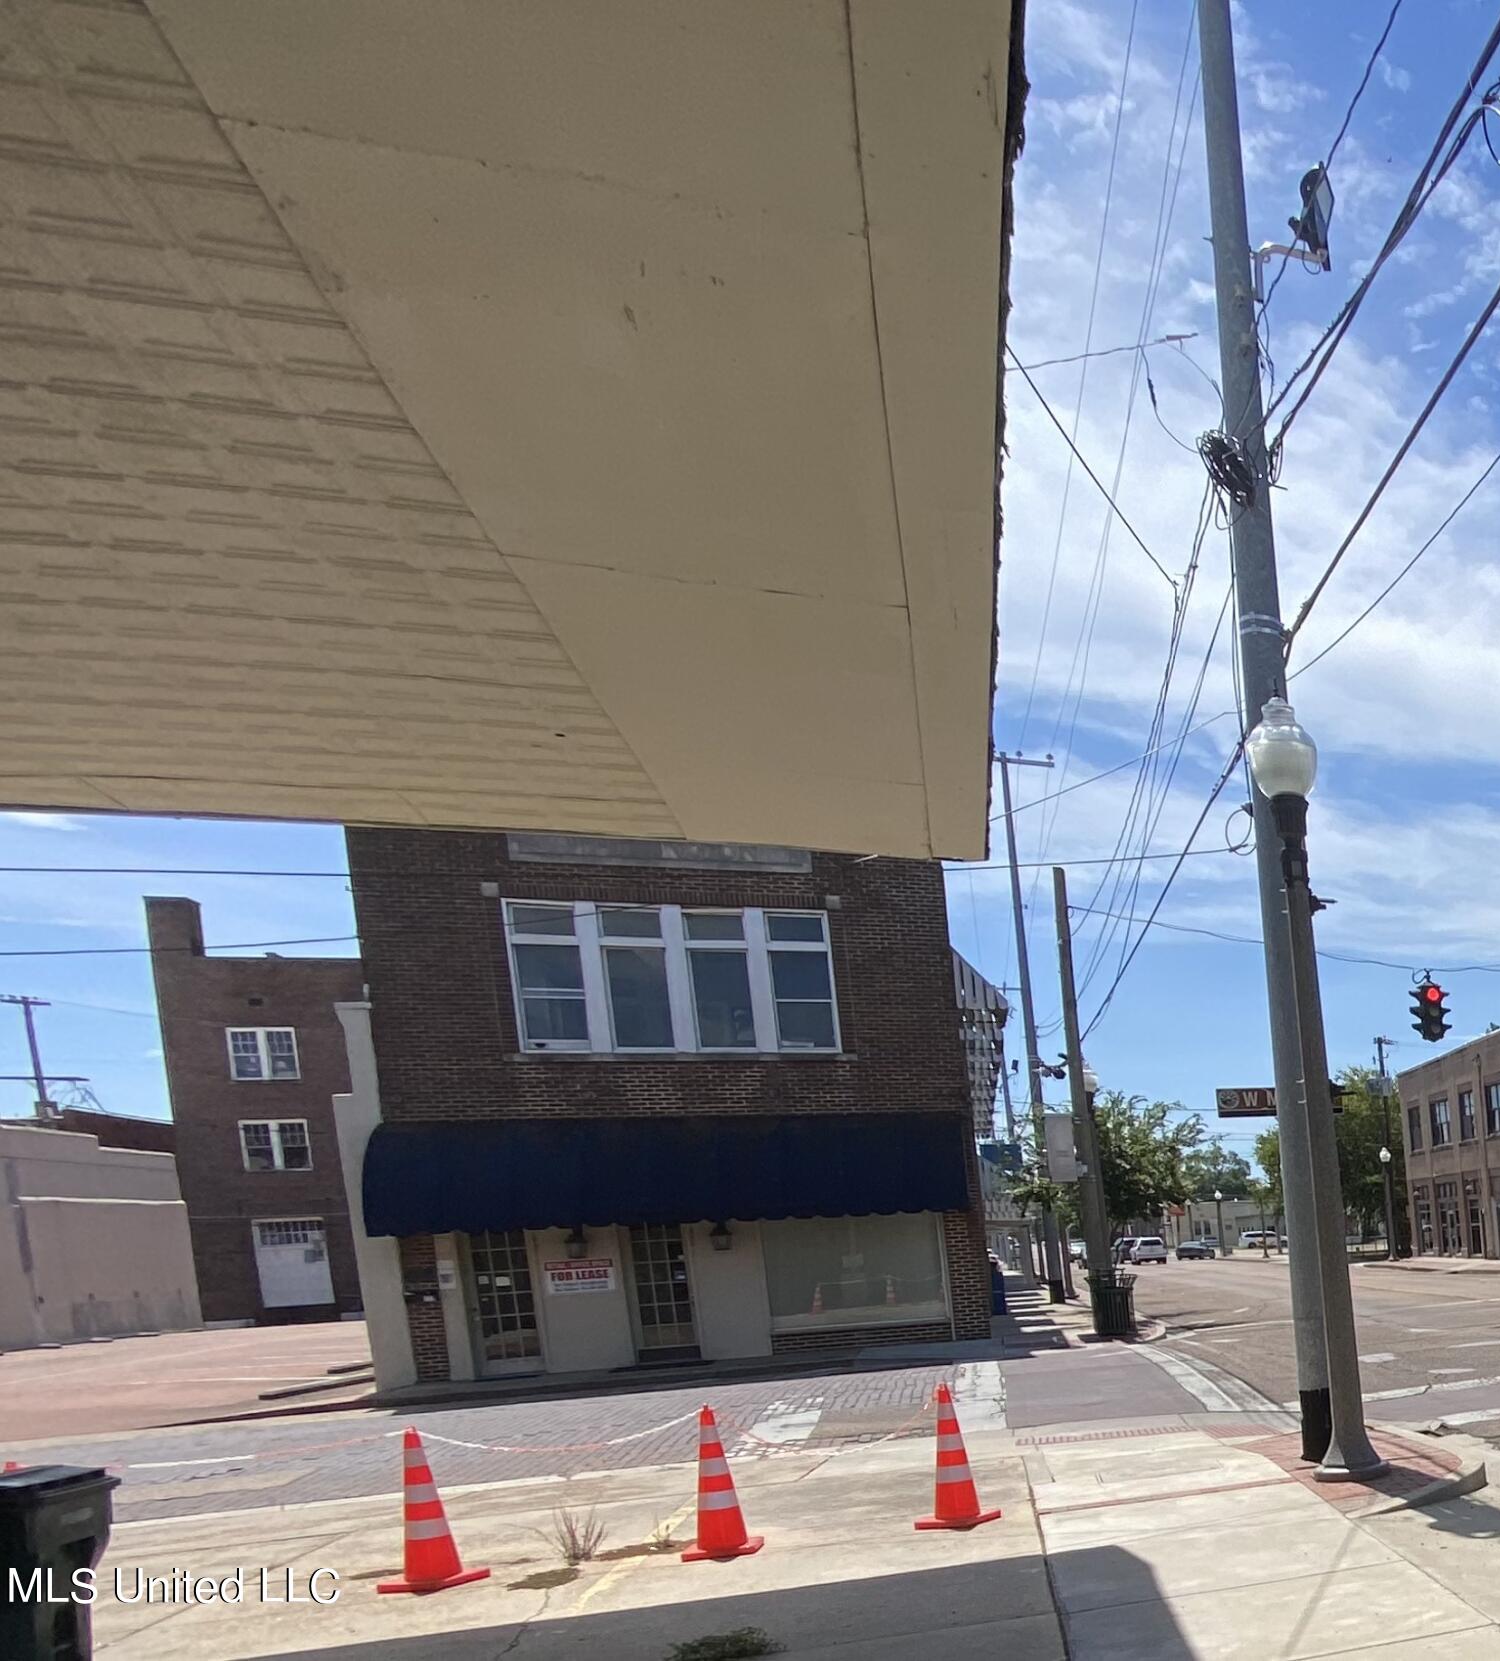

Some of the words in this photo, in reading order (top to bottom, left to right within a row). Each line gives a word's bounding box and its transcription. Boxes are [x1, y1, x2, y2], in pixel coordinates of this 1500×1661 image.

[1242, 1091, 1258, 1107] W
[551, 1271, 573, 1281] FOR
[576, 1269, 609, 1280] LEASE
